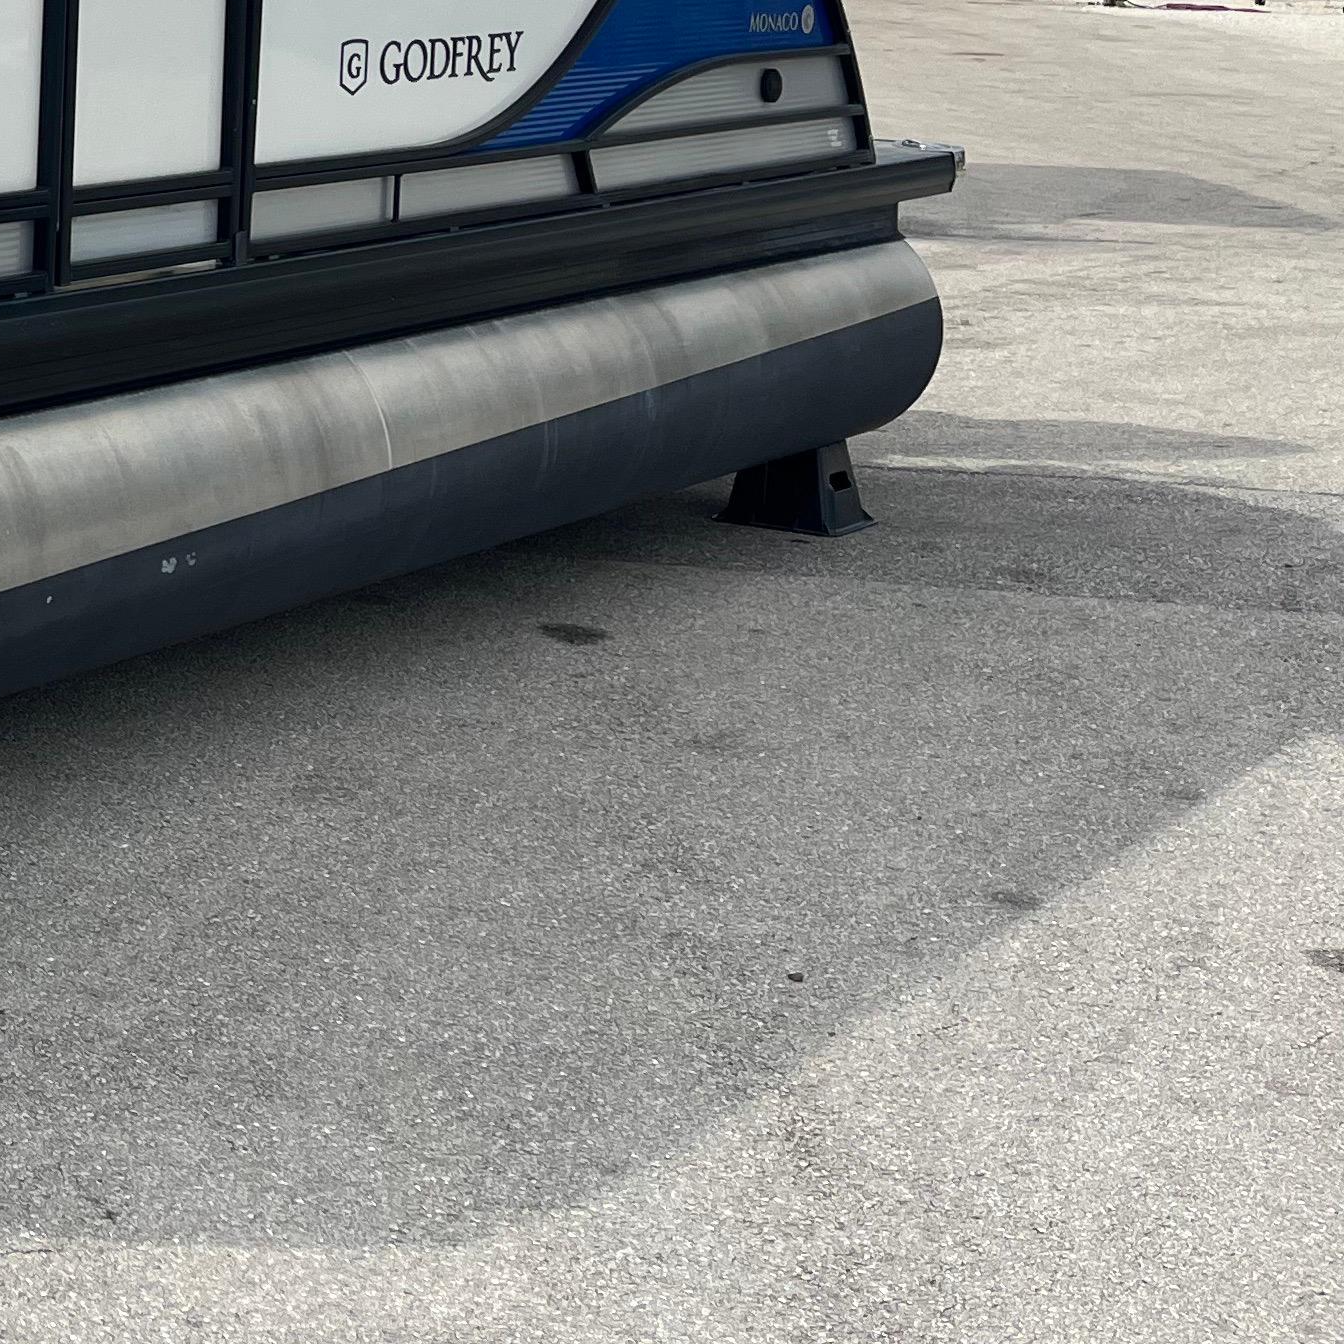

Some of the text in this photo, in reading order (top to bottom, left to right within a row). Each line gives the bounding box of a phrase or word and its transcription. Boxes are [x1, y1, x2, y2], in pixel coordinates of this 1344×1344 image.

[748, 11, 799, 33] MONACO
[347, 30, 525, 85] G GODFREY
